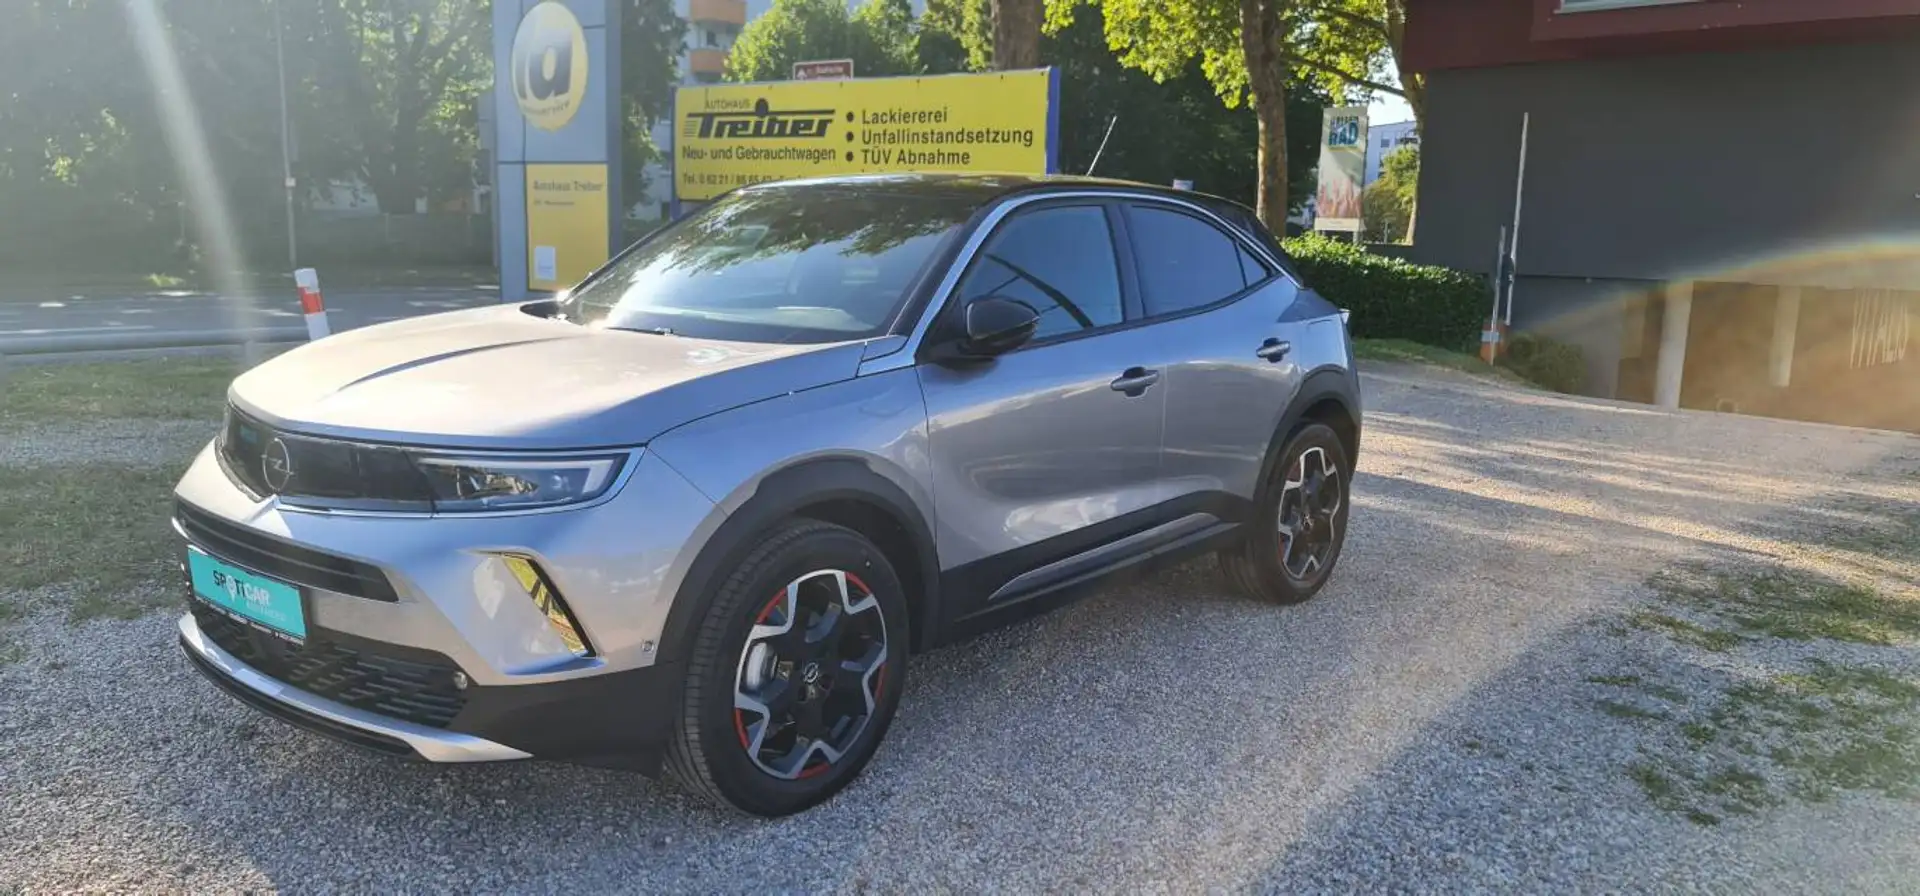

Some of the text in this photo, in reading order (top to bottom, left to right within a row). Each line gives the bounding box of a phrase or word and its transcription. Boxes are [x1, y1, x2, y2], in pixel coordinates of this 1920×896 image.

[705, 98, 750, 109] AUTOHAUS
[862, 106, 948, 125] Lackiererei
[862, 128, 1033, 148] Unfallinstandsetzung
[682, 144, 836, 165] Neu- und Gebrauchtwagen
[861, 147, 971, 165] TÜV Abnahme
